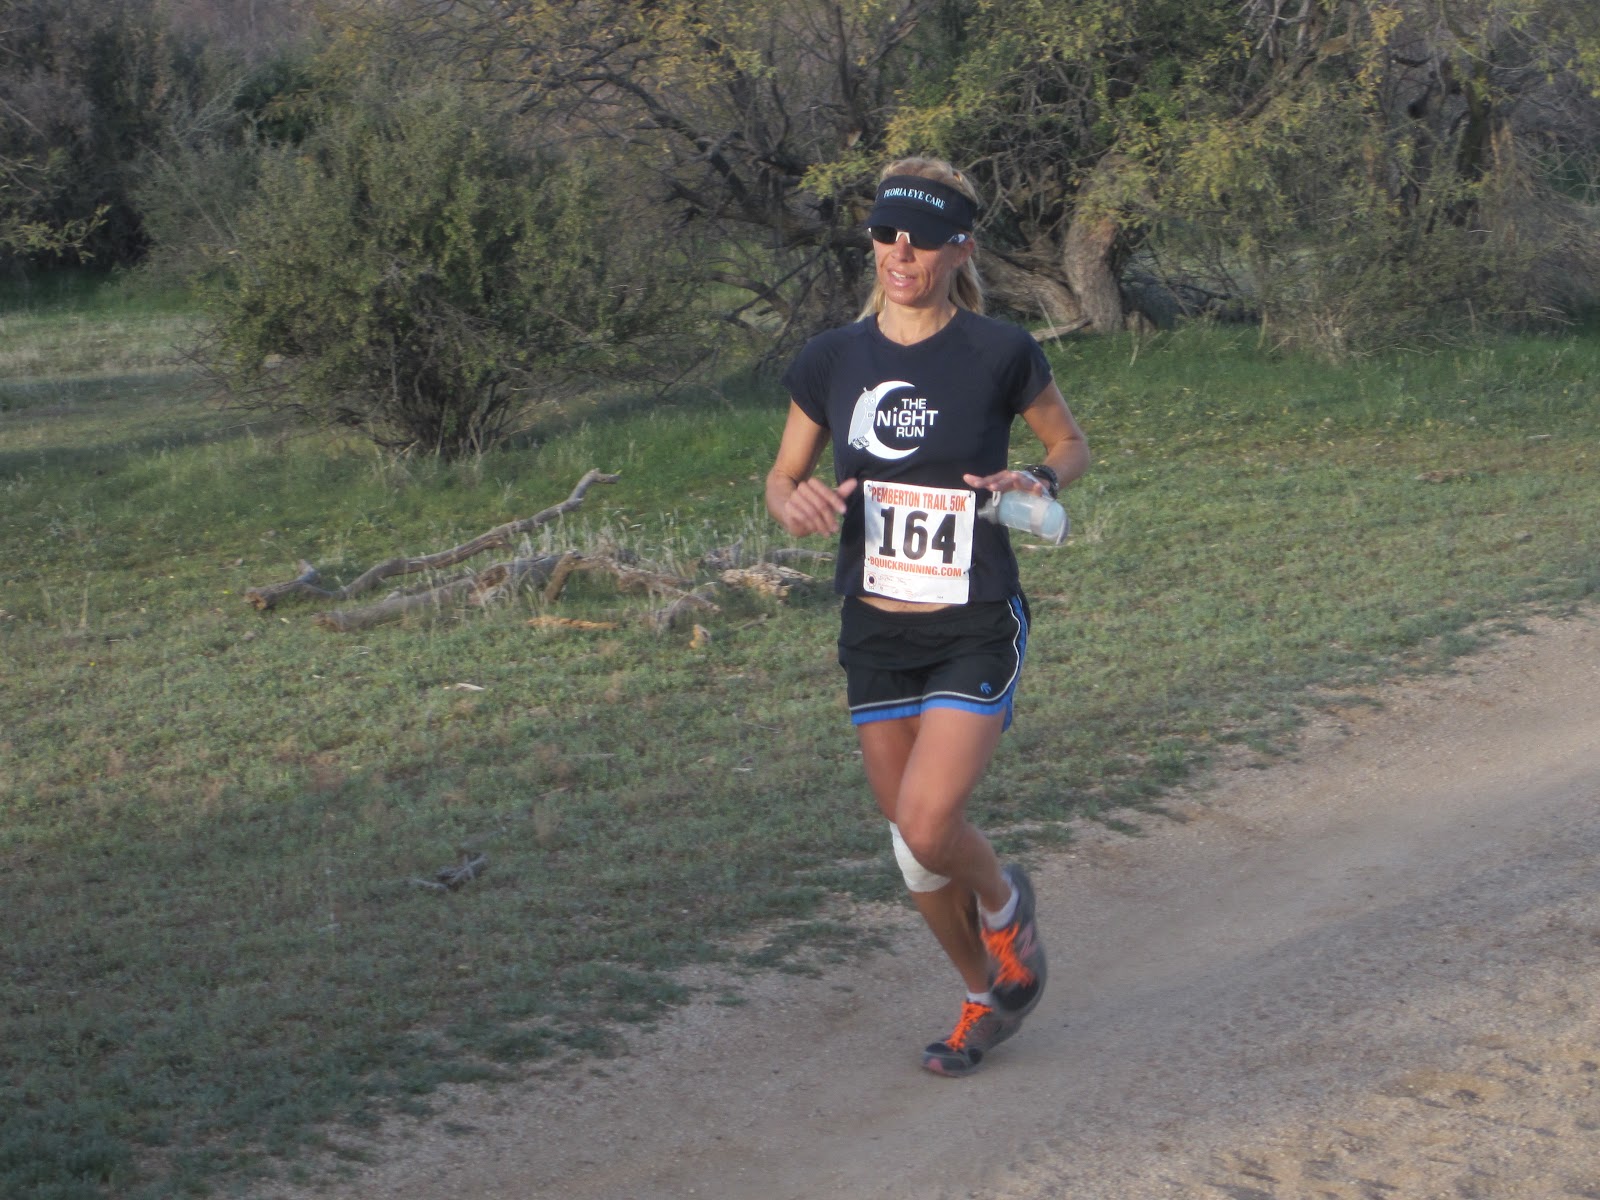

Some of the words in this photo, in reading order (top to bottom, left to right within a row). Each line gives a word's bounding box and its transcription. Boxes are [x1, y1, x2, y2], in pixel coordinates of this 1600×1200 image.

[884, 187, 907, 198] PEORIA
[908, 188, 925, 200] EYE
[925, 193, 946, 209] CARE
[901, 398, 927, 410] THE
[896, 426, 925, 438] RUN
[871, 486, 920, 508] PEMBERTON
[922, 492, 948, 511] TRAIL
[949, 495, 968, 512] 50K
[878, 506, 957, 565] 164
[869, 556, 962, 577] BQUICKRUNNING.COM
